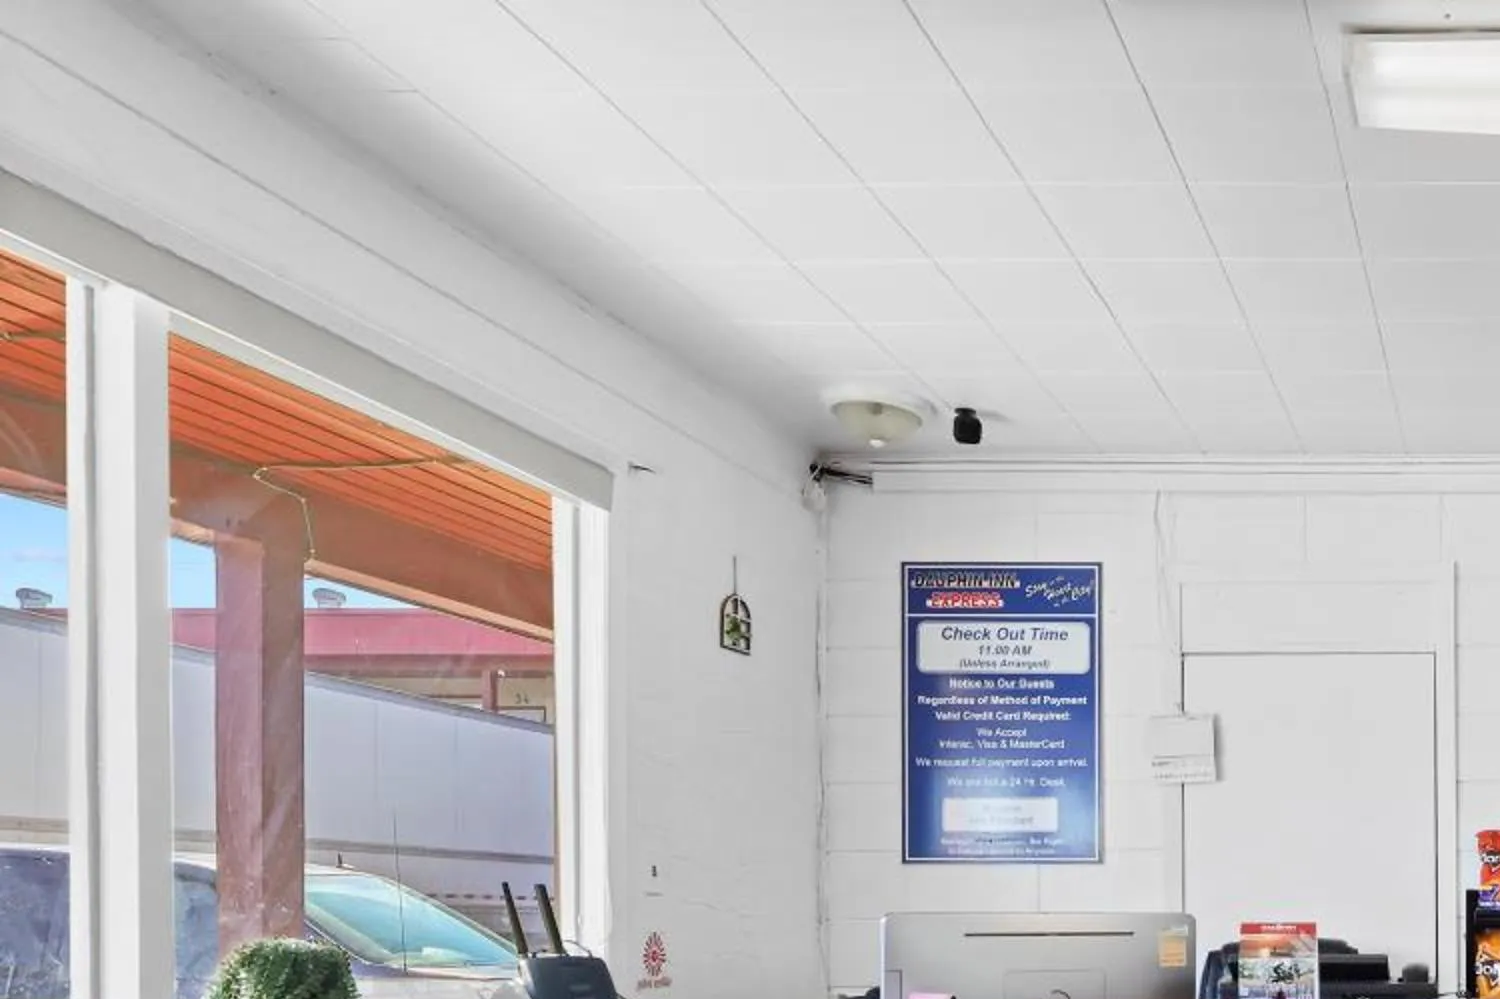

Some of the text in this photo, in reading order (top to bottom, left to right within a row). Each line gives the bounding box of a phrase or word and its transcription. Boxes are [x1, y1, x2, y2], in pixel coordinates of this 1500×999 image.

[912, 572, 1017, 588] DAUPHIN INN
[929, 591, 1001, 608] EXPRESS
[941, 627, 1069, 641] Check Out Time
[1011, 645, 1033, 656] AM
[949, 678, 1055, 689] Notice to Our Guests
[917, 695, 1088, 707] Regardless of Method of Payment
[935, 711, 961, 721] Valid
[963, 711, 994, 721] Credit
[995, 711, 1022, 721] Card
[994, 727, 1027, 738] Accept
[977, 739, 997, 749] Visa
[999, 739, 1007, 749] &
[1009, 739, 1066, 749] MasterCard
[915, 757, 932, 767] We
[987, 757, 1029, 769] payment
[1031, 758, 1054, 768] upon
